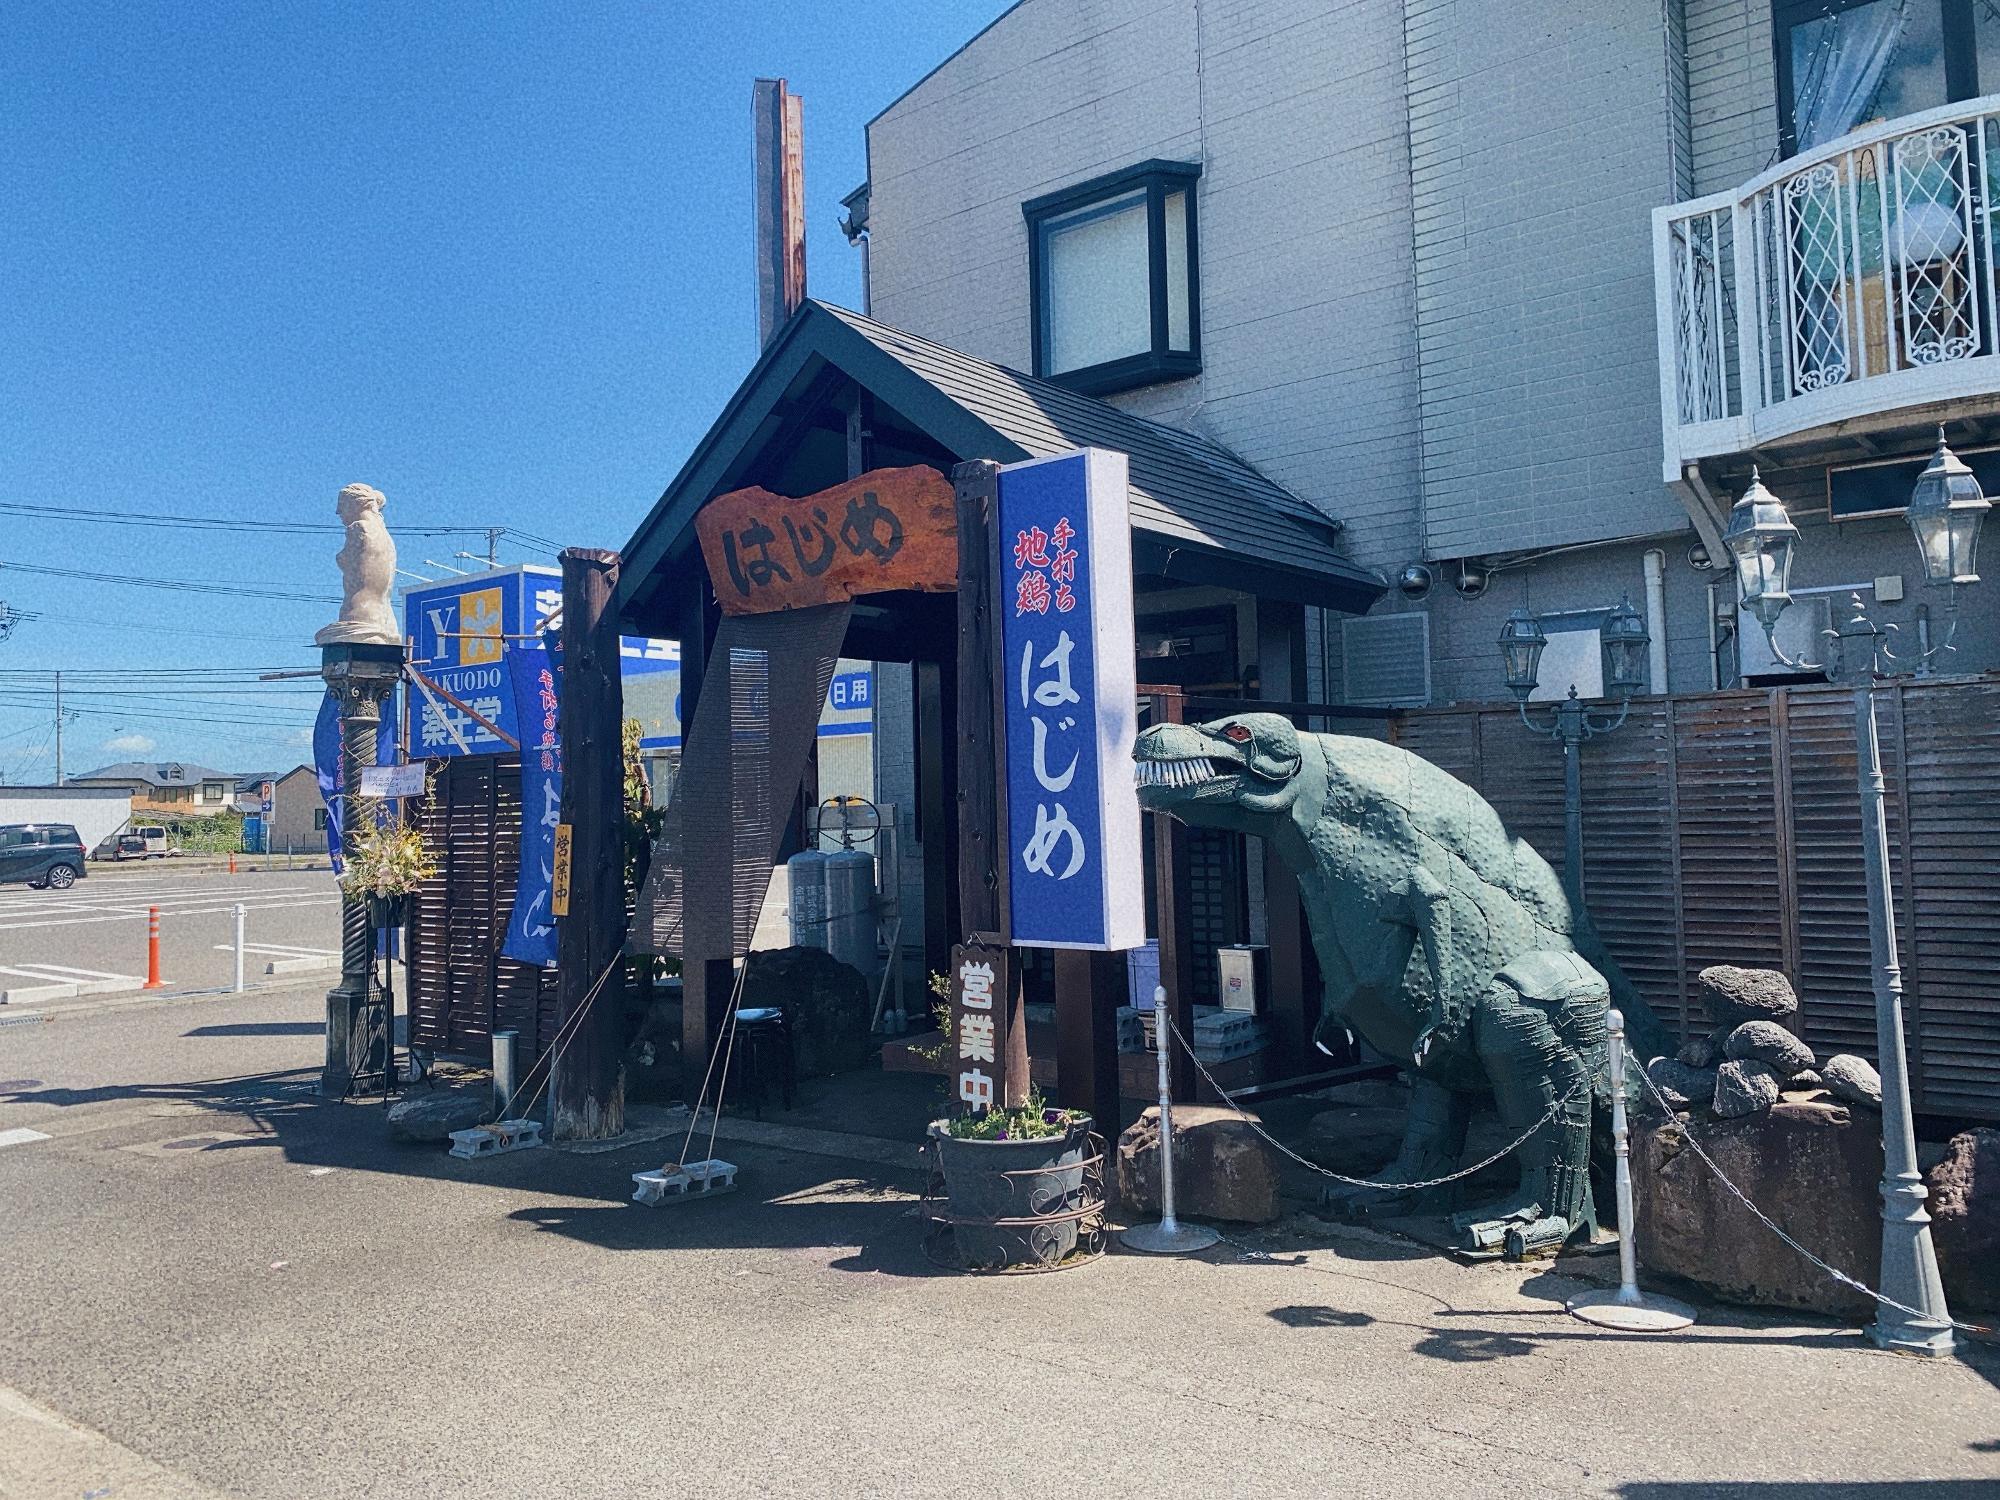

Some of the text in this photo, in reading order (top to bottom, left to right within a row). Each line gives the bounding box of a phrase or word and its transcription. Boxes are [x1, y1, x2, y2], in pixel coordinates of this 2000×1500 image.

[722, 491, 904, 597] はじめ
[1014, 527, 1052, 619] 地鶏
[1051, 517, 1078, 614] 手打ち
[426, 606, 456, 660] Y
[421, 695, 502, 748] 薬王堂
[1021, 630, 1086, 881] はじめ
[554, 834, 570, 907] 営業中
[959, 959, 995, 1112] 営業中
